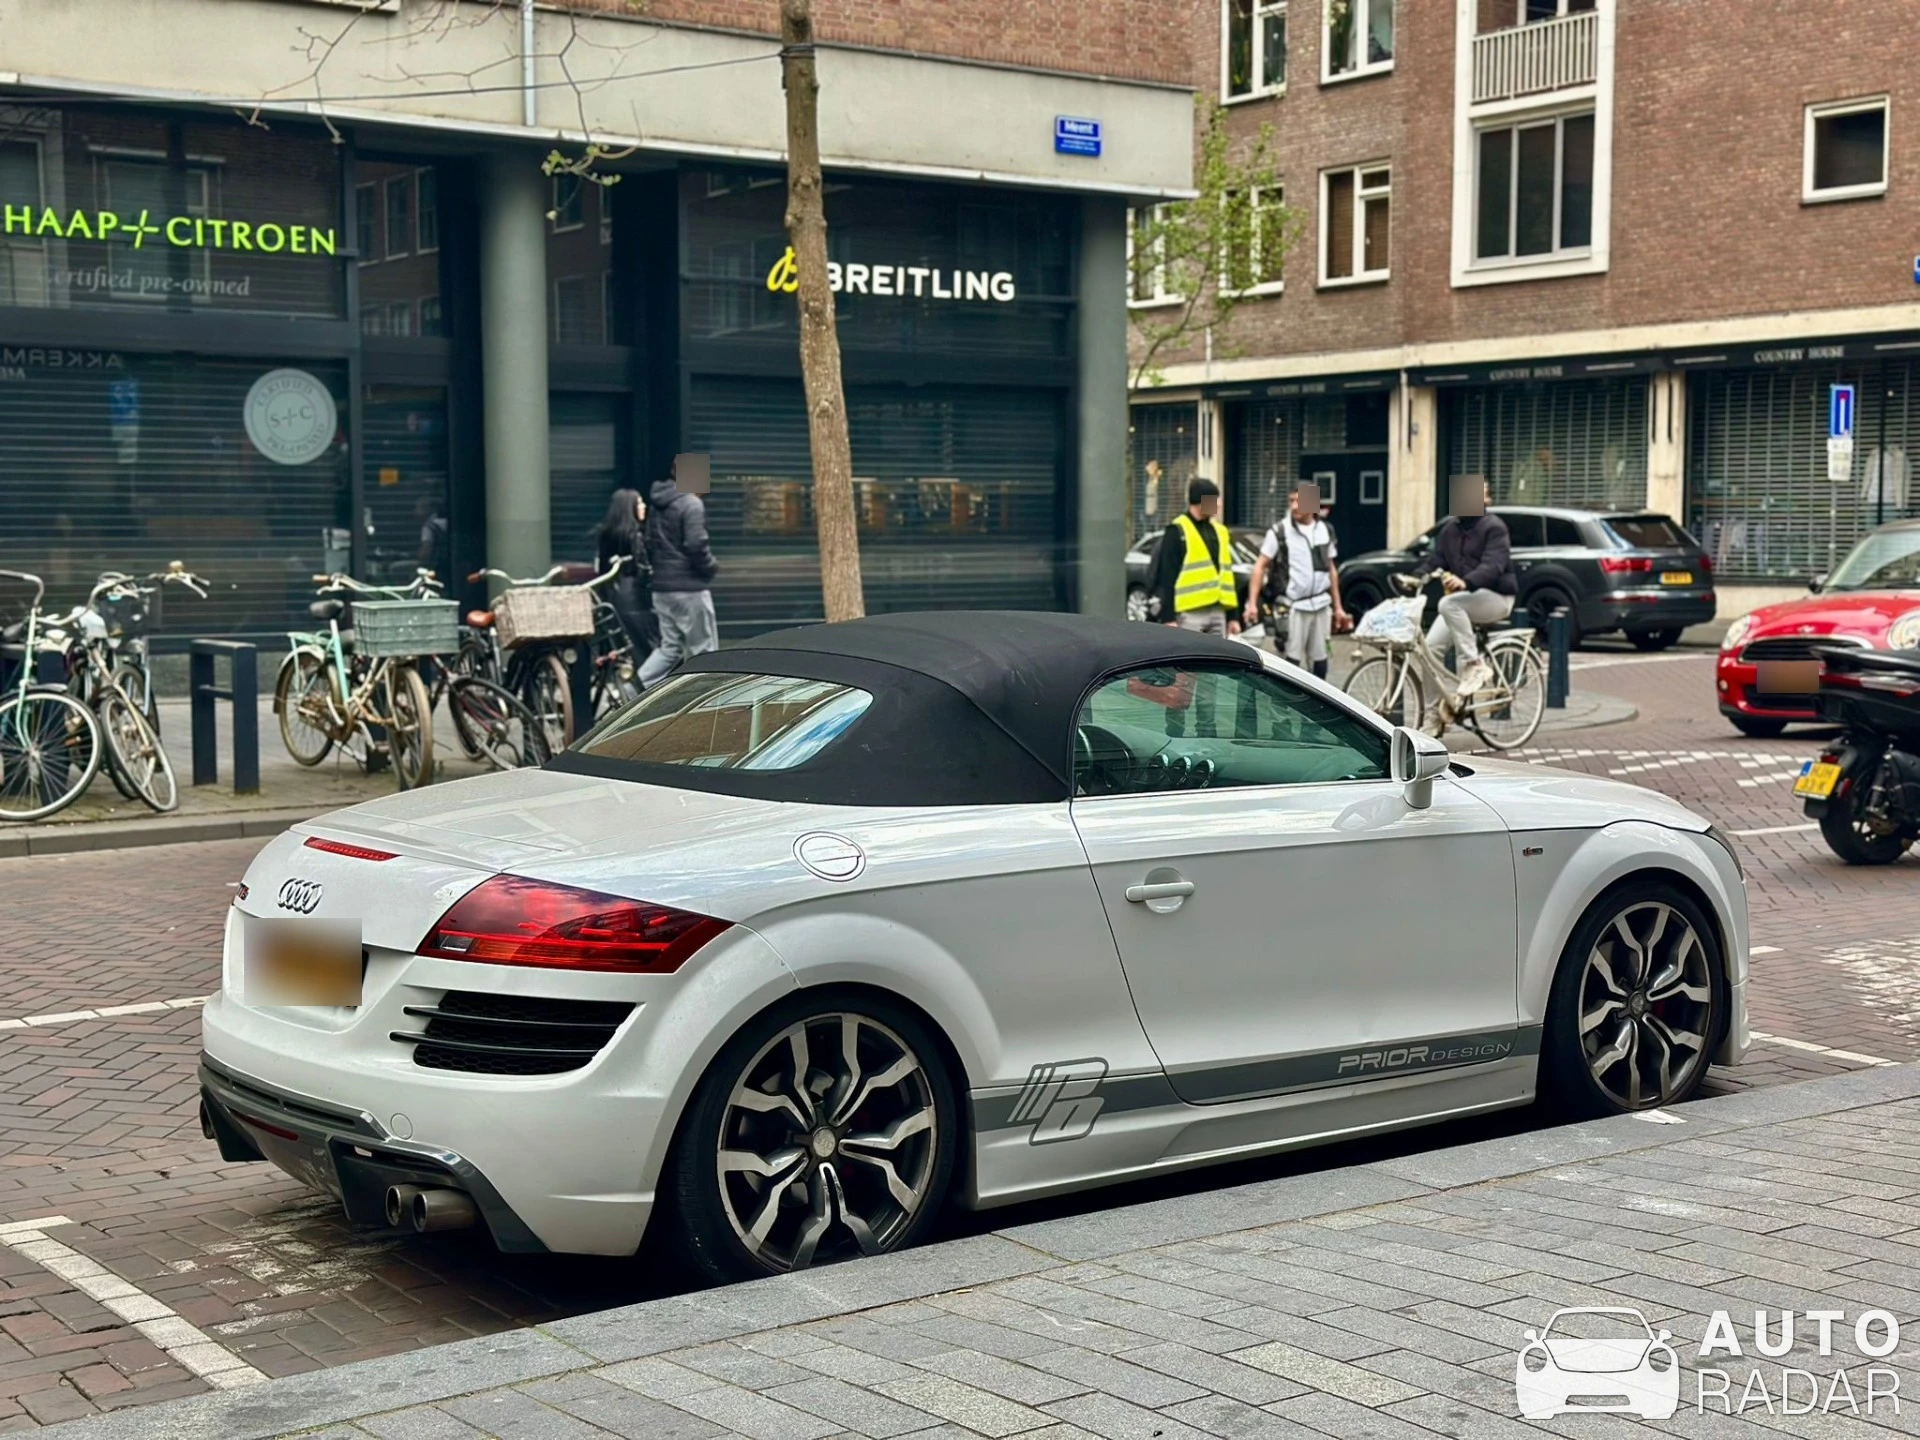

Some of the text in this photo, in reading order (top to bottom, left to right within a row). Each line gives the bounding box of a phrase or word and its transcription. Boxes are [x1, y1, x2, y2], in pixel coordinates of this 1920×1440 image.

[139, 272, 251, 297] pre-owned
[1337, 1042, 1511, 1074] PRIOR DESIGN
